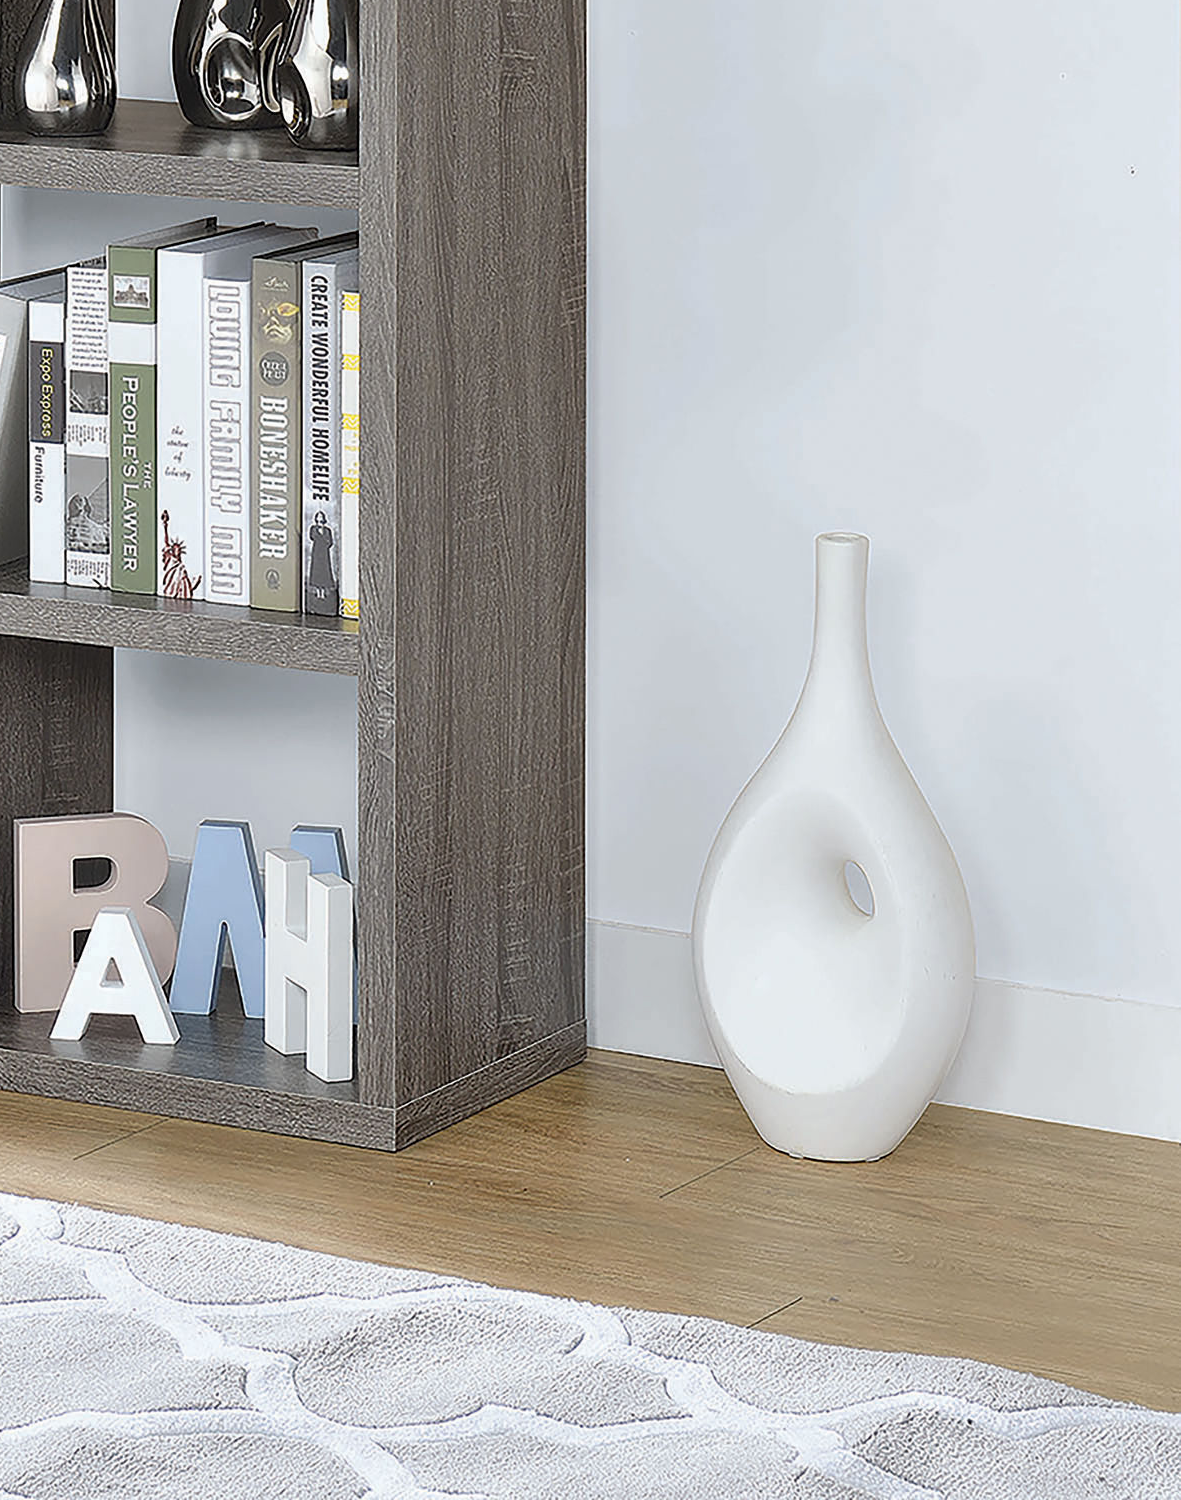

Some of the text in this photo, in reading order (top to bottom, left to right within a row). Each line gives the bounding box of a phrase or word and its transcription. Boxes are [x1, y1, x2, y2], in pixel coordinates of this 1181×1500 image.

[38, 348, 54, 437] Expo Express
[310, 275, 329, 501] CREATE WONDERFUL HOMELIFE
[34, 446, 45, 503] Furniture
[121, 376, 140, 571] PEOPLE'S LAWYER
[142, 461, 153, 489] THE
[209, 400, 243, 513] FAMILY
[259, 395, 288, 559] BONESHAKER
[210, 525, 243, 596] MAN
